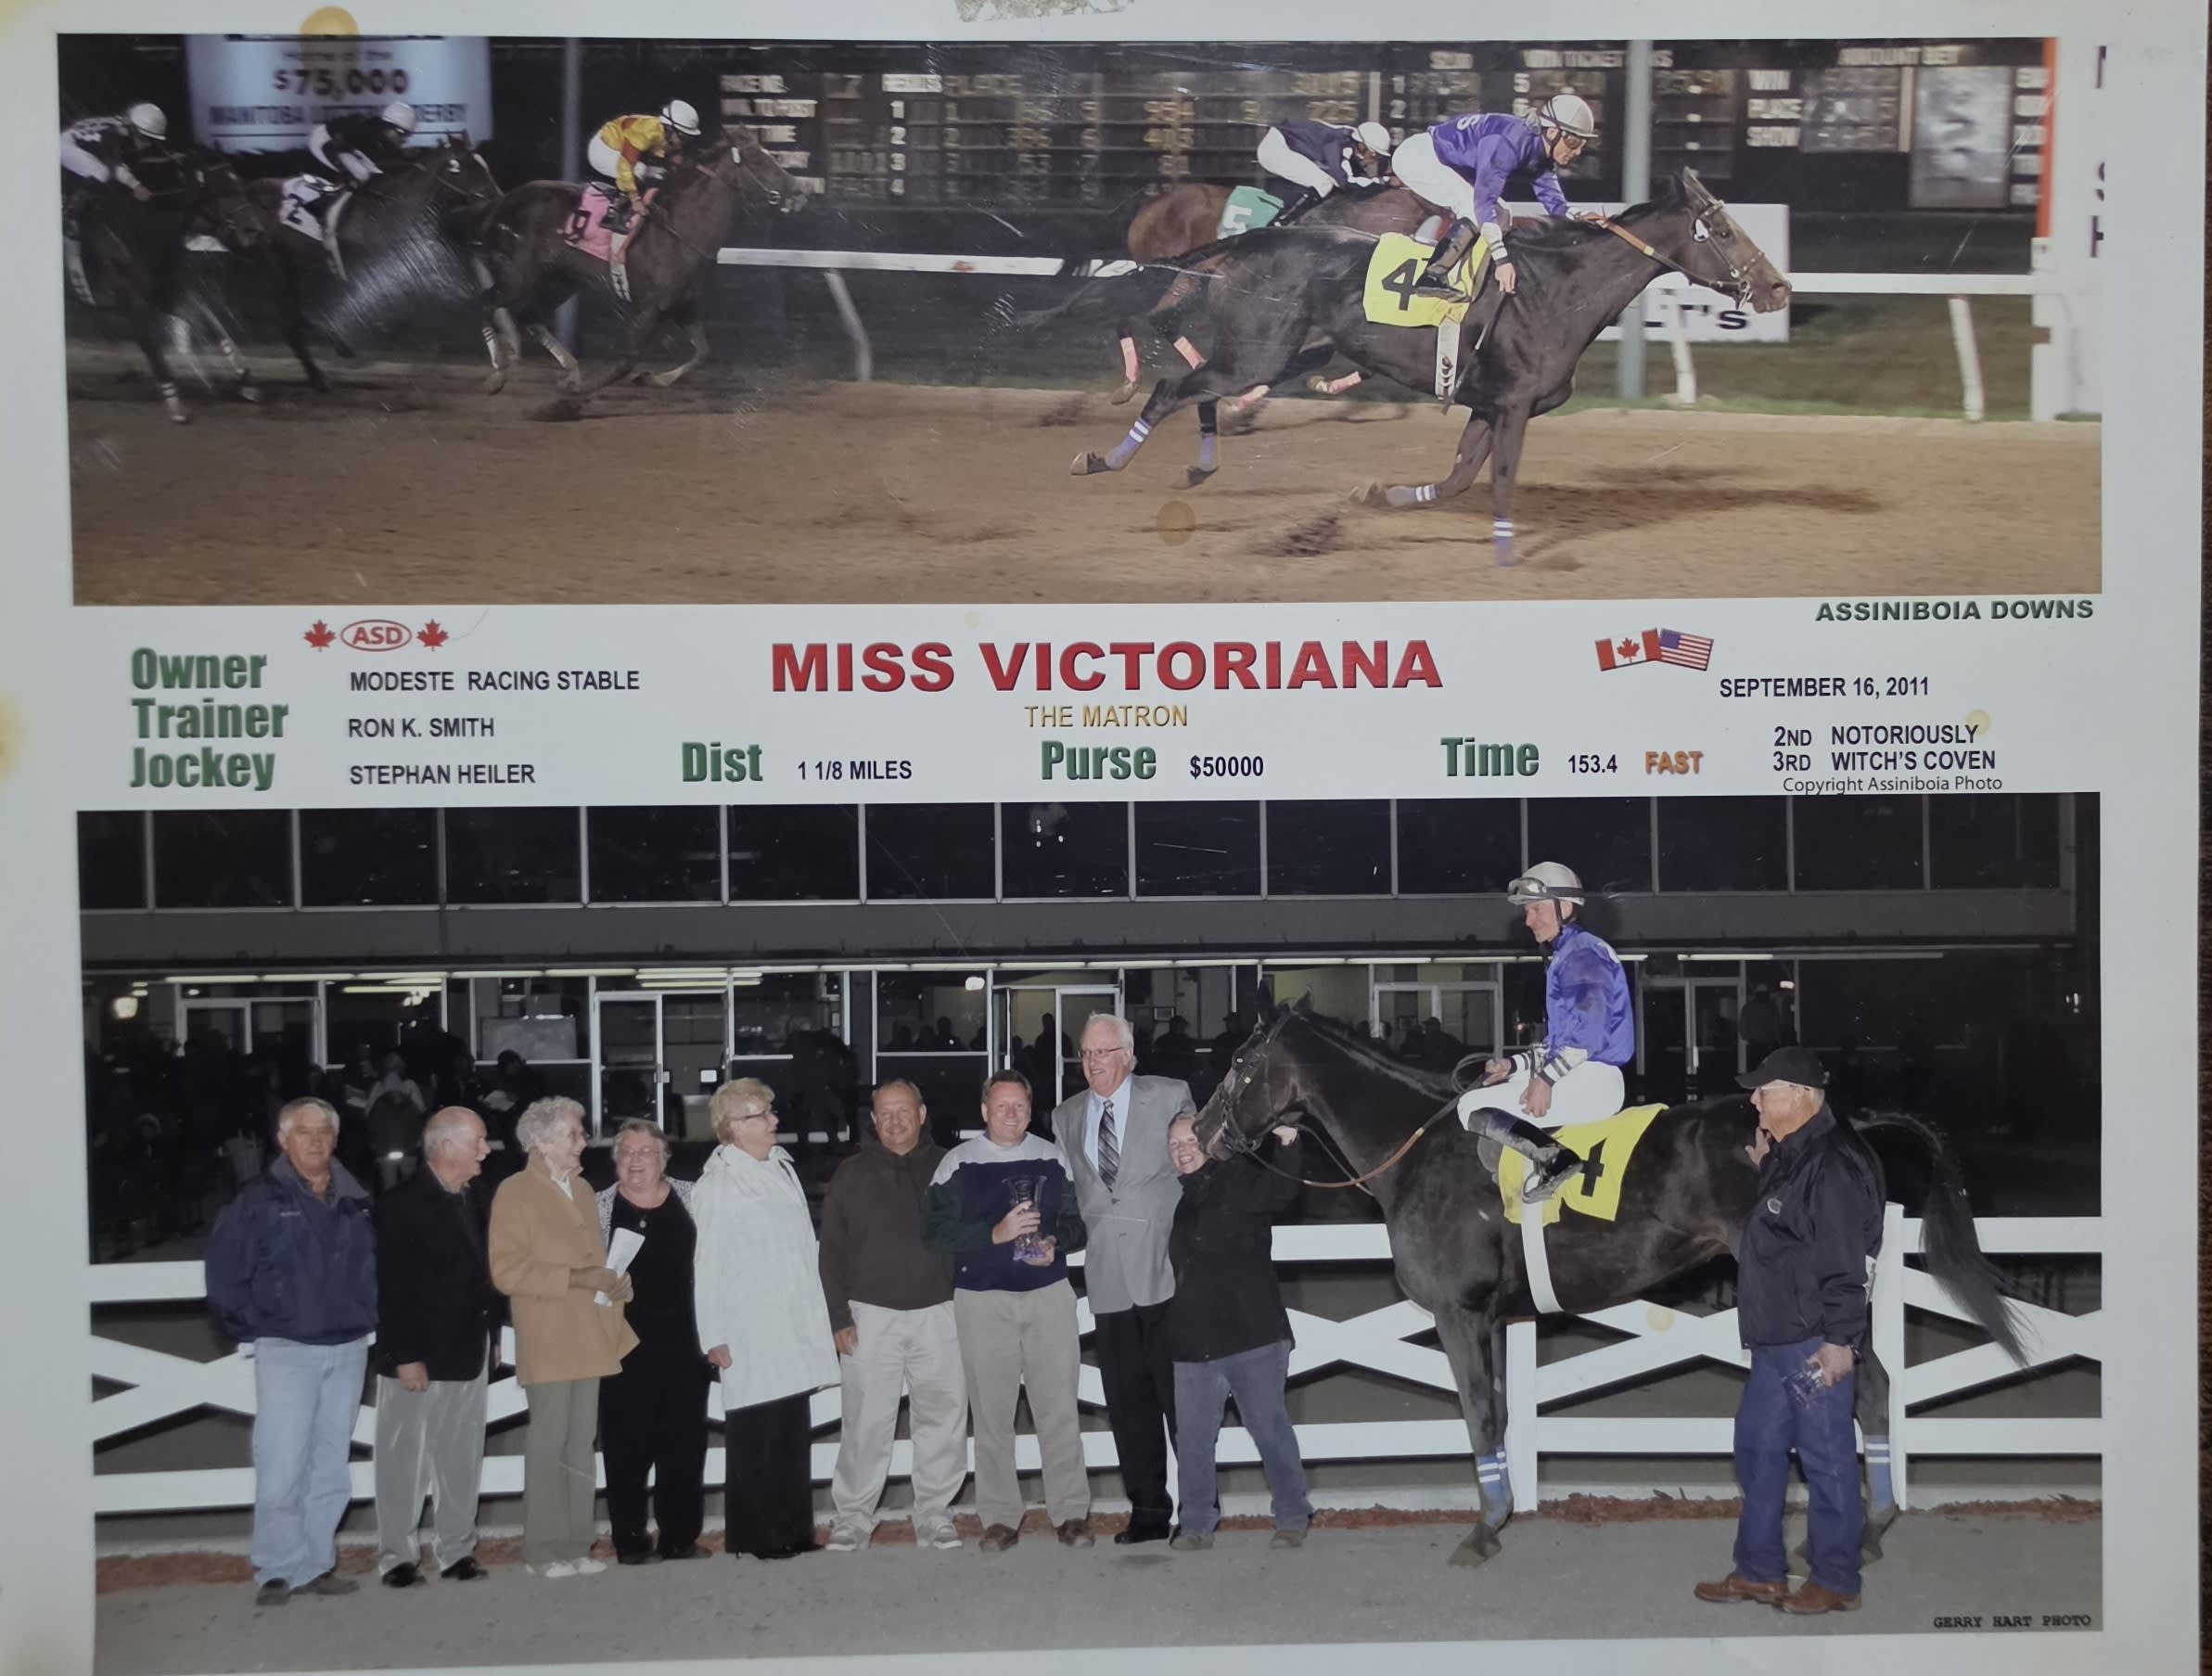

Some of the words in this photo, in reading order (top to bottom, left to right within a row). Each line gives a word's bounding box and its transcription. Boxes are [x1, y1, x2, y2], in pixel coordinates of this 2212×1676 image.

[273, 68, 409, 100] $75,000
[890, 126, 906, 144] 2
[890, 152, 905, 171] 3
[288, 192, 304, 225] 2
[1217, 204, 1253, 240] 5
[1381, 258, 1419, 312] 4
[1815, 601, 1983, 621] ASSINIBOIA
[1990, 599, 2094, 620] DOWNS
[352, 626, 403, 646] ASD
[131, 647, 268, 691] Owner
[771, 641, 955, 693] MISS
[978, 639, 1444, 692] VICTORIANA
[350, 671, 455, 692] MODESTE
[467, 670, 550, 691] RACING
[556, 670, 641, 691] STABLE
[1719, 677, 1848, 698] SEPTEMBER
[1853, 676, 1880, 700] 16,
[1886, 675, 1928, 697] 2011
[131, 697, 289, 739] Trainer
[348, 717, 395, 738] RON
[401, 717, 423, 738] K.
[428, 717, 495, 738] SMITH
[1023, 705, 1073, 728] THE
[1082, 704, 1188, 728] MATRON
[1773, 725, 1812, 748] 2ND
[1831, 724, 1980, 746] NOTORIOUSLY
[682, 741, 764, 783] Dist
[1041, 740, 1157, 781] Purse
[1189, 754, 1265, 780] $50000
[1439, 736, 1540, 777] Time
[1567, 753, 1618, 774] 153.4
[1644, 749, 1705, 775] FAST
[1772, 750, 1812, 772] 3RD
[1831, 750, 1917, 772] WITCH'S
[1924, 749, 1996, 771] COVEN
[129, 747, 275, 792] Jockey
[350, 763, 452, 786] STEPHAN
[457, 763, 536, 785] HEILER
[798, 761, 806, 781] 1
[814, 760, 843, 781] 1/8
[850, 760, 913, 780] MILES
[1783, 776, 1864, 797] Copyright
[1868, 775, 1950, 791] Assiniboia
[1954, 774, 2003, 790] Photo
[1933, 1616, 1983, 1629] GERRY
[1992, 1615, 2033, 1628] HART
[2041, 1614, 2092, 1627] PHOTO
